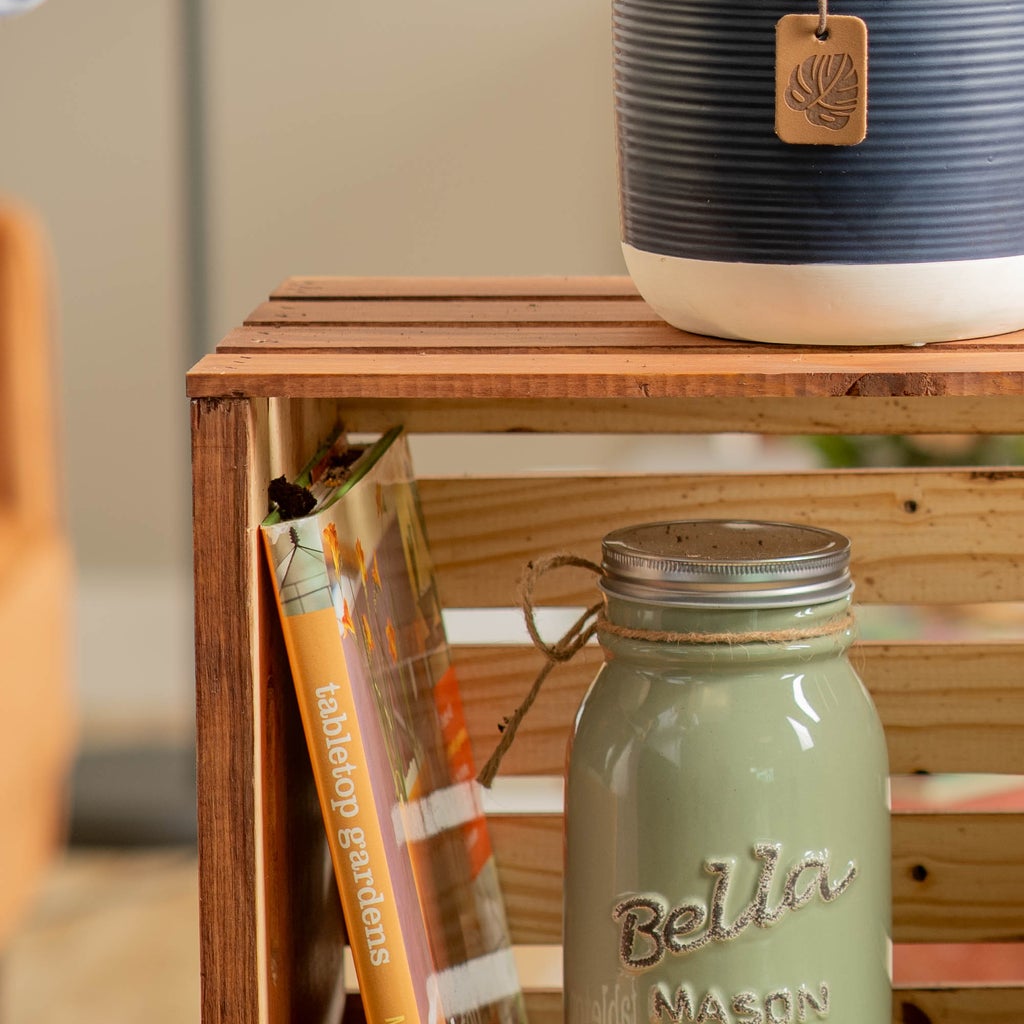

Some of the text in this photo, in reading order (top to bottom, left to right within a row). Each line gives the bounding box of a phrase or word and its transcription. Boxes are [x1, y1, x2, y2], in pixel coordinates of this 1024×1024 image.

[313, 681, 391, 968] tabletop gardens
[612, 840, 858, 969] Bella
[650, 980, 830, 1024] MASON
